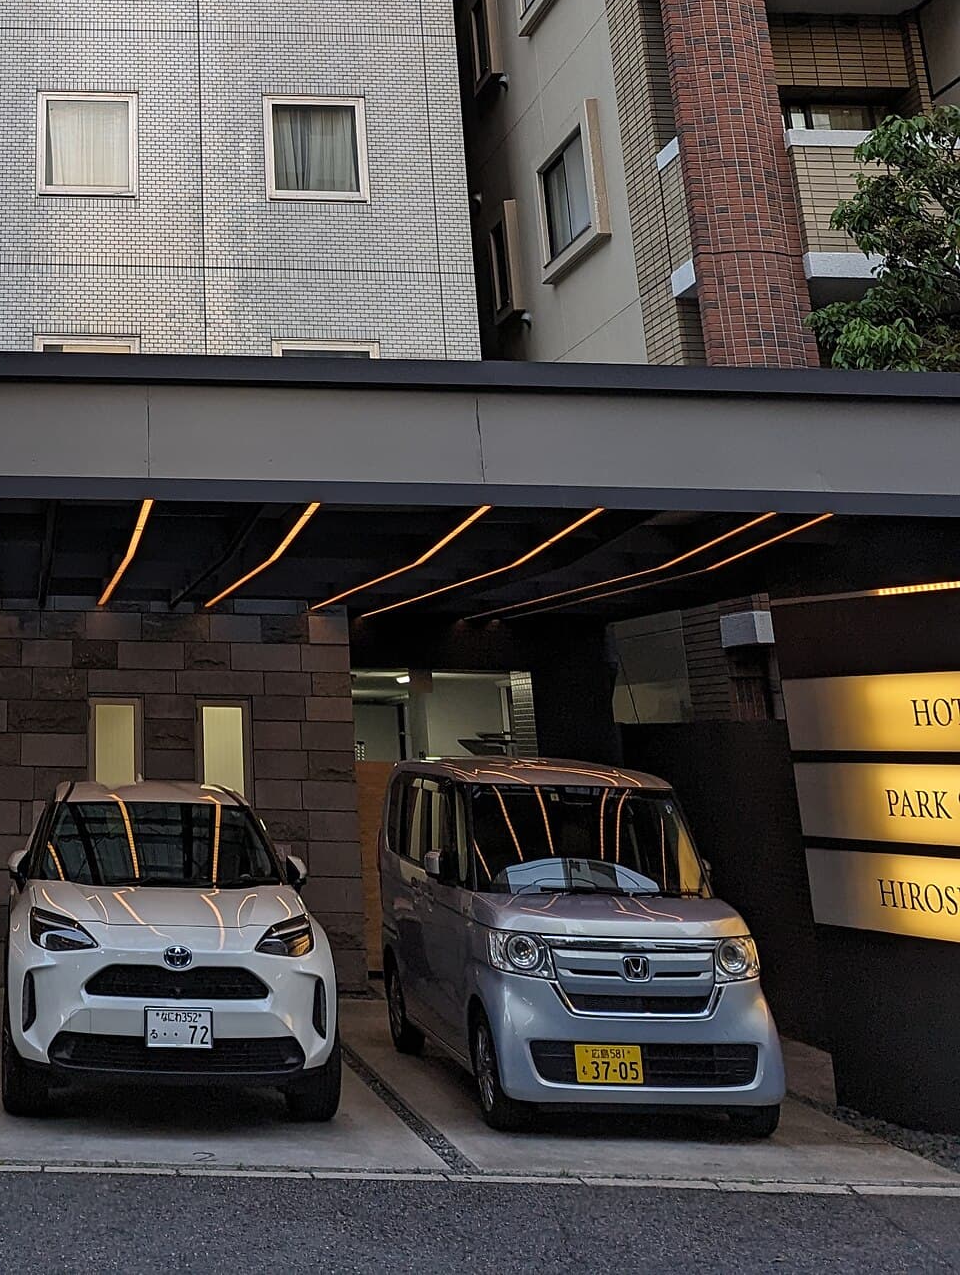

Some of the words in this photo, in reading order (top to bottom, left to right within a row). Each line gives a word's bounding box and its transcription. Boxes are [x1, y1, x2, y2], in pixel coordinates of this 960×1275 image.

[884, 789, 953, 820] PARK
[877, 878, 960, 916] HIROS
[591, 1060, 639, 1080] 37-05
